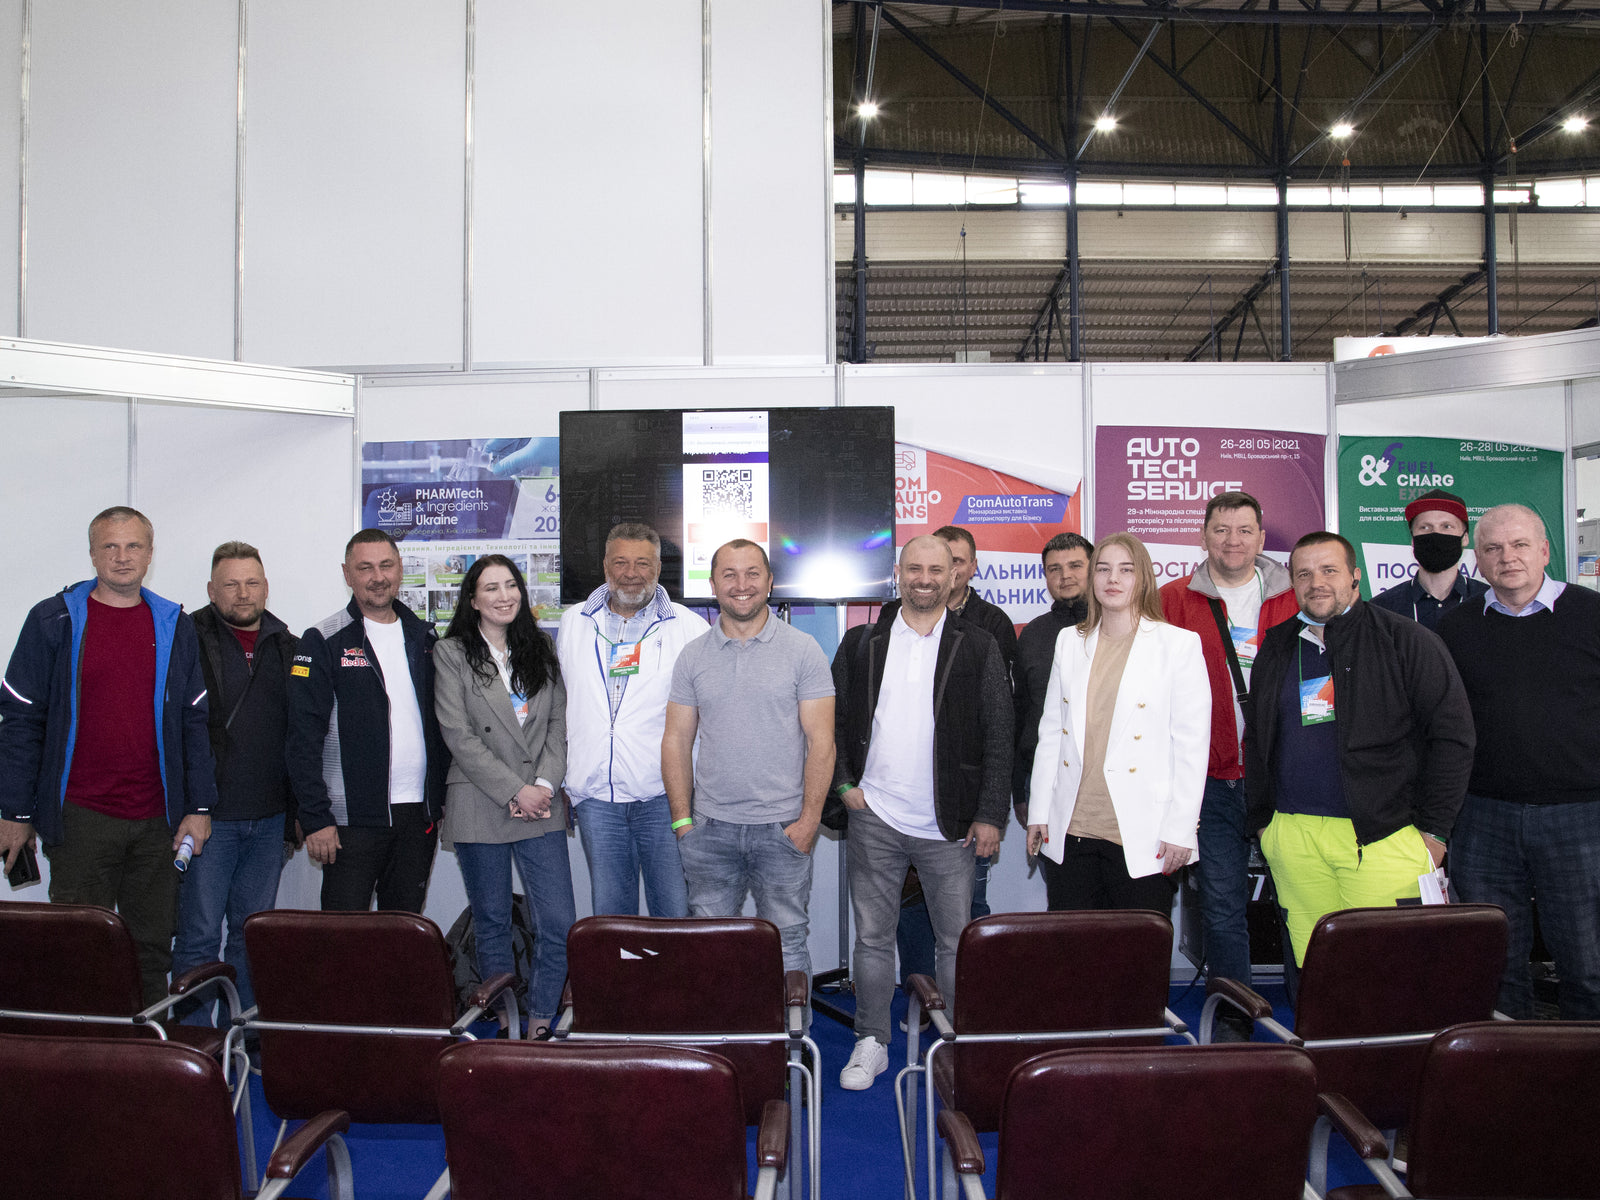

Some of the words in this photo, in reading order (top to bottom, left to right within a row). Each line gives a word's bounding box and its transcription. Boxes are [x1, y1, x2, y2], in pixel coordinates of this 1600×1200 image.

[1127, 438, 1200, 457] AUTO
[1127, 459, 1197, 479] TECH
[1398, 461, 1438, 474] FUEL
[1396, 474, 1455, 487] CHARG
[415, 487, 484, 500] PHARMTech
[427, 500, 489, 515] Ingredients
[967, 496, 1054, 508] ComAutoTrans
[1359, 505, 1388, 513] Виставка
[415, 514, 458, 526] Ukraine
[1127, 517, 1165, 526] автосервісу
